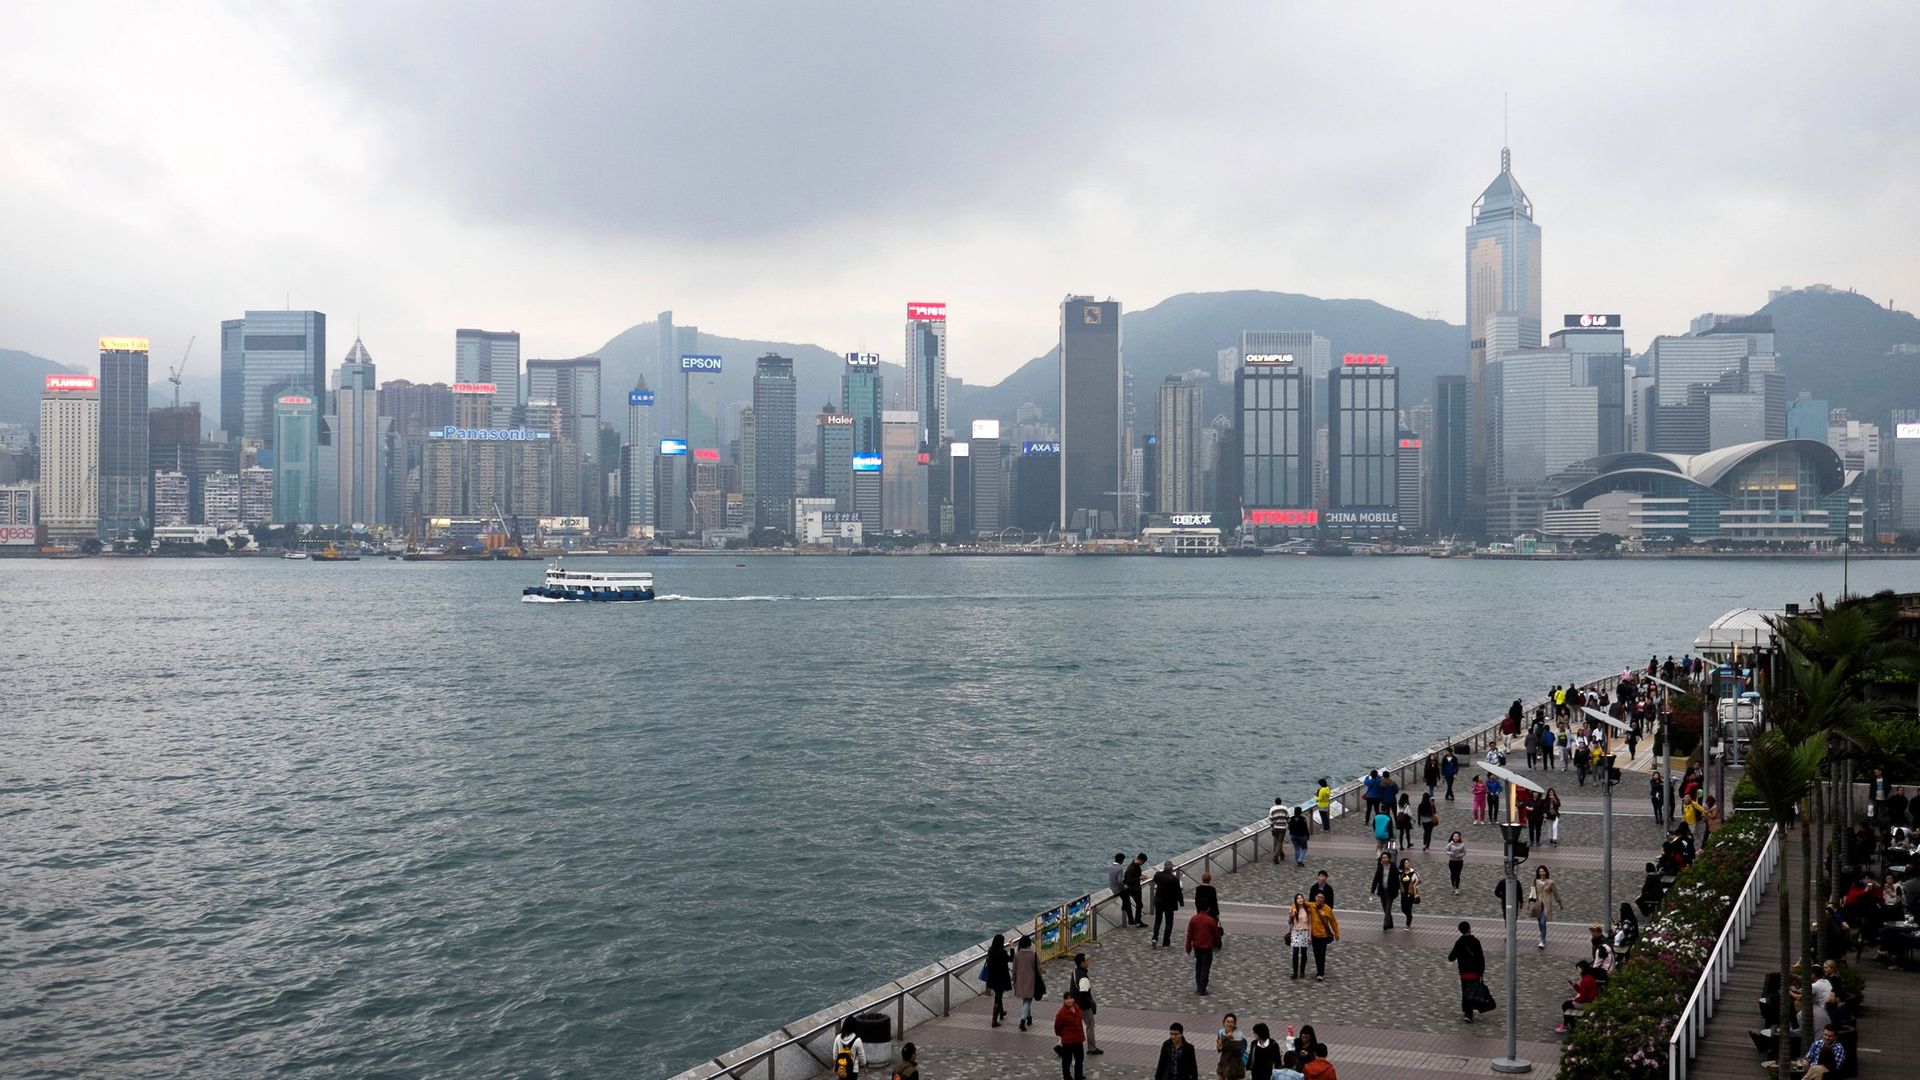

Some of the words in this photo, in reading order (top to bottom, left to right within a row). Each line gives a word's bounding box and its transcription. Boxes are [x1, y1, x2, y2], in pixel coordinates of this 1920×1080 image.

[1245, 354, 1294, 362] OLYMPUS
[682, 358, 721, 368] EPSON
[51, 379, 93, 387] PLANNING
[452, 383, 497, 392] TOSHIBA
[828, 416, 853, 424] Haier
[444, 426, 536, 440] Panasonic
[1031, 444, 1051, 452] AXA
[1325, 513, 1357, 522] CHINA
[1359, 513, 1398, 522] MOBILE
